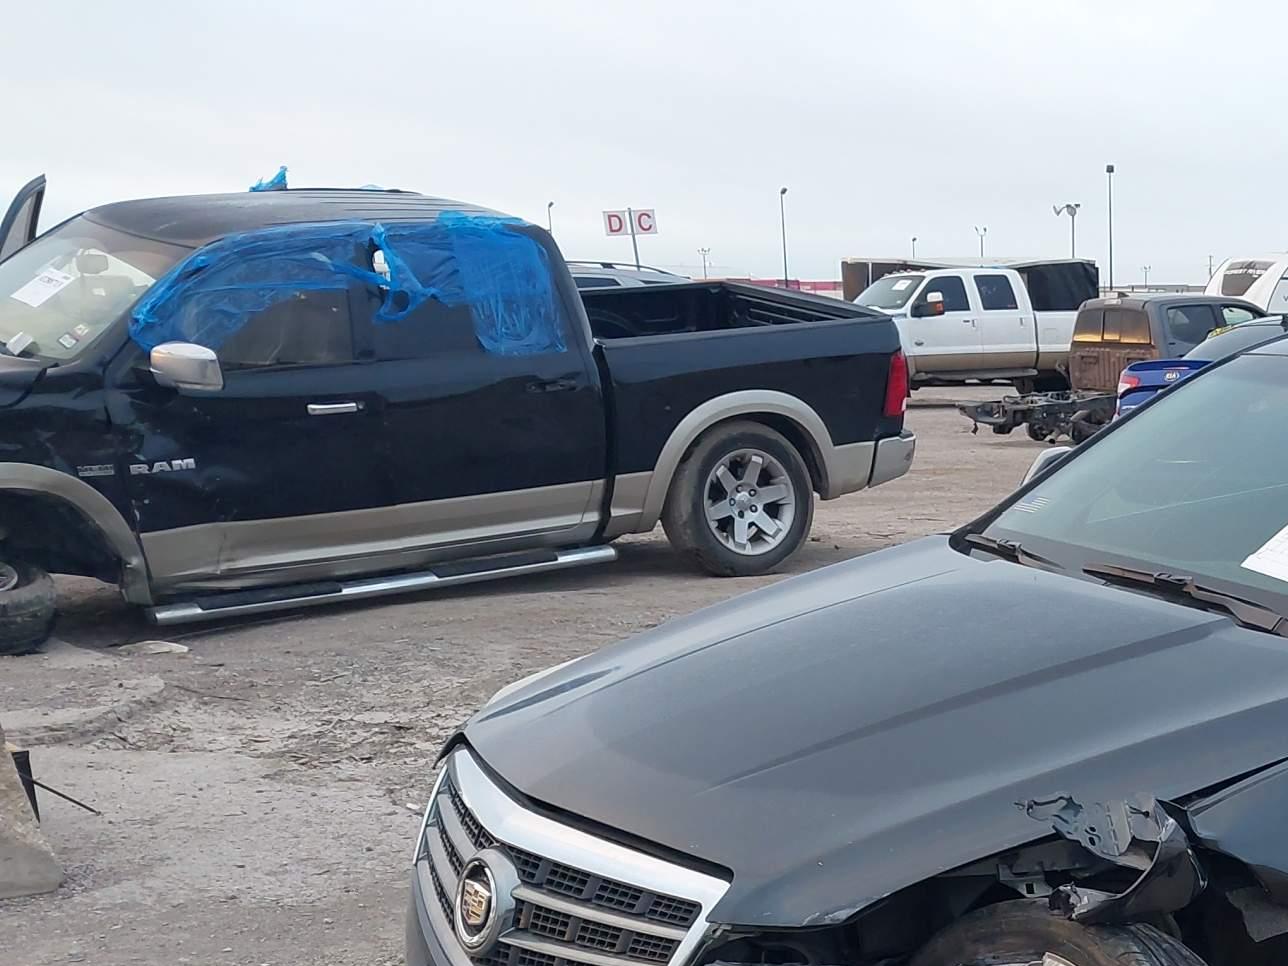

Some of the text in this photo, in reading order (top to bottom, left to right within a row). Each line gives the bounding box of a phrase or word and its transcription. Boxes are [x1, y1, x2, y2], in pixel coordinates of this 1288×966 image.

[608, 214, 623, 233] D
[637, 212, 653, 232] C
[129, 458, 196, 475] RAM
